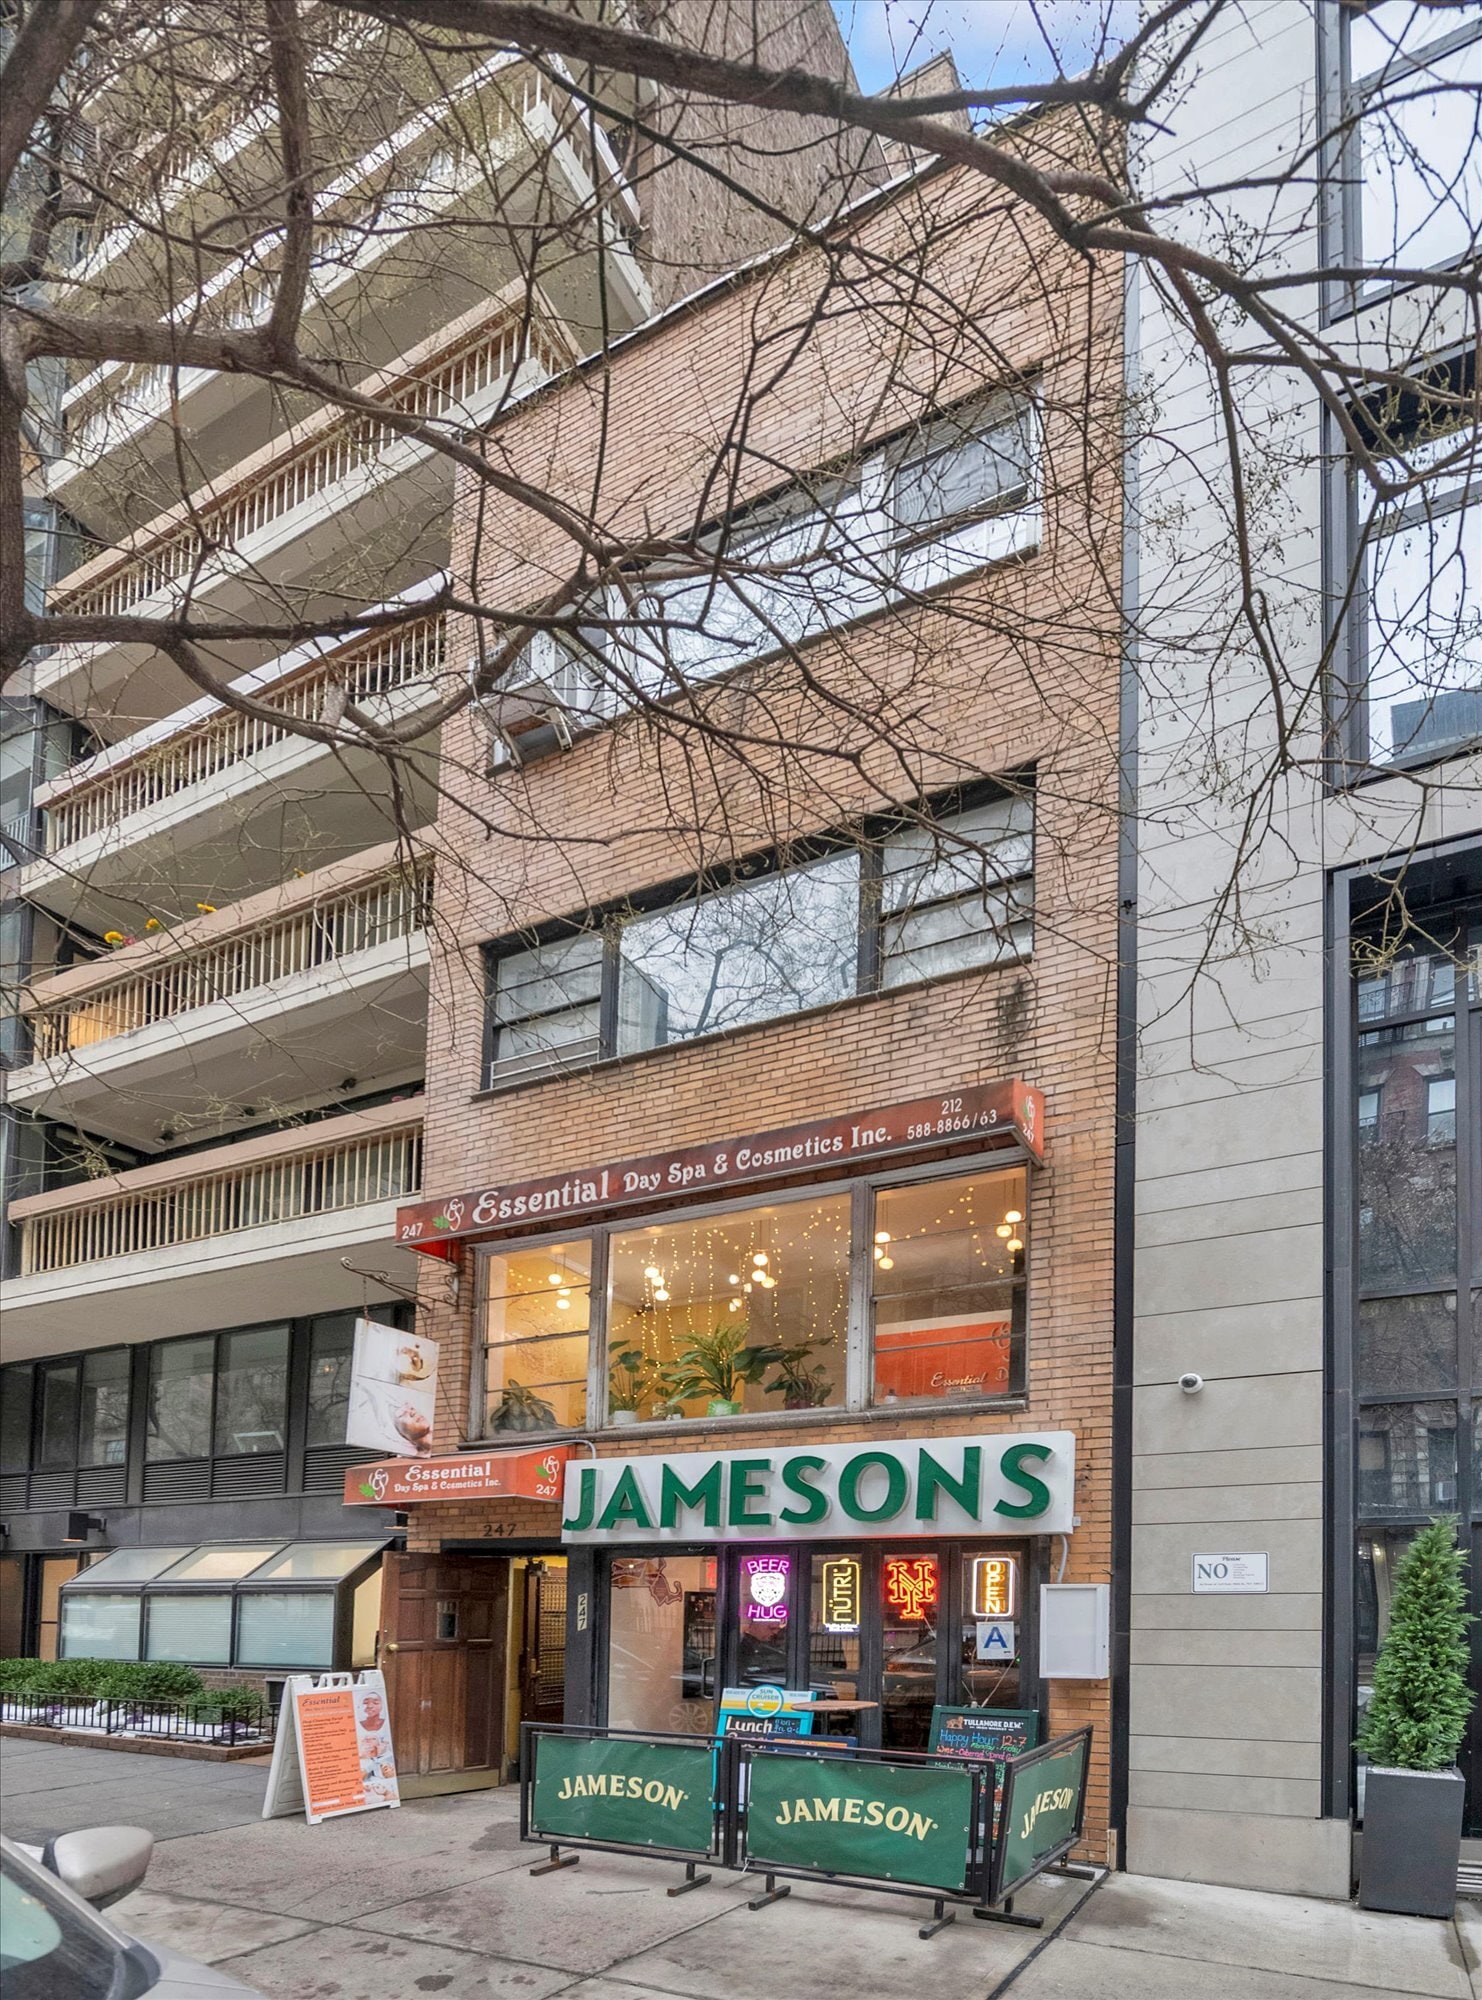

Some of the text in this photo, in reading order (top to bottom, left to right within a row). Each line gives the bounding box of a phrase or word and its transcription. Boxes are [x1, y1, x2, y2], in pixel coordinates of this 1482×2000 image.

[941, 1098, 962, 1116] 212
[907, 1109, 998, 1140] 588-8866/63
[472, 1126, 892, 1225] Essential Day Spa & Cosmetics Inc.
[401, 1222, 424, 1240] 247
[930, 1371, 989, 1388] Essential
[405, 1461, 491, 1482] Essential
[394, 1478, 501, 1493] Day Spa & Cosmetics Inc.
[535, 1484, 557, 1496] 247
[563, 1442, 1054, 1532] JAMESONS
[483, 1523, 517, 1537] 247
[746, 1558, 790, 1575] BEER
[1197, 1563, 1228, 1579] NO
[985, 1562, 1002, 1613] OPEN
[577, 1594, 587, 1630] 247
[747, 1605, 788, 1619] HUG
[983, 1626, 1008, 1648] A
[302, 1695, 341, 1706] Essential
[726, 1716, 773, 1733] Lunch
[964, 1719, 1002, 1727] TULLAMORE
[940, 1729, 1027, 1748] Happy Hour 12-7
[970, 1742, 995, 1751] Monday
[558, 1774, 686, 1811] JAMESON
[775, 1797, 935, 1841] JAMESON
